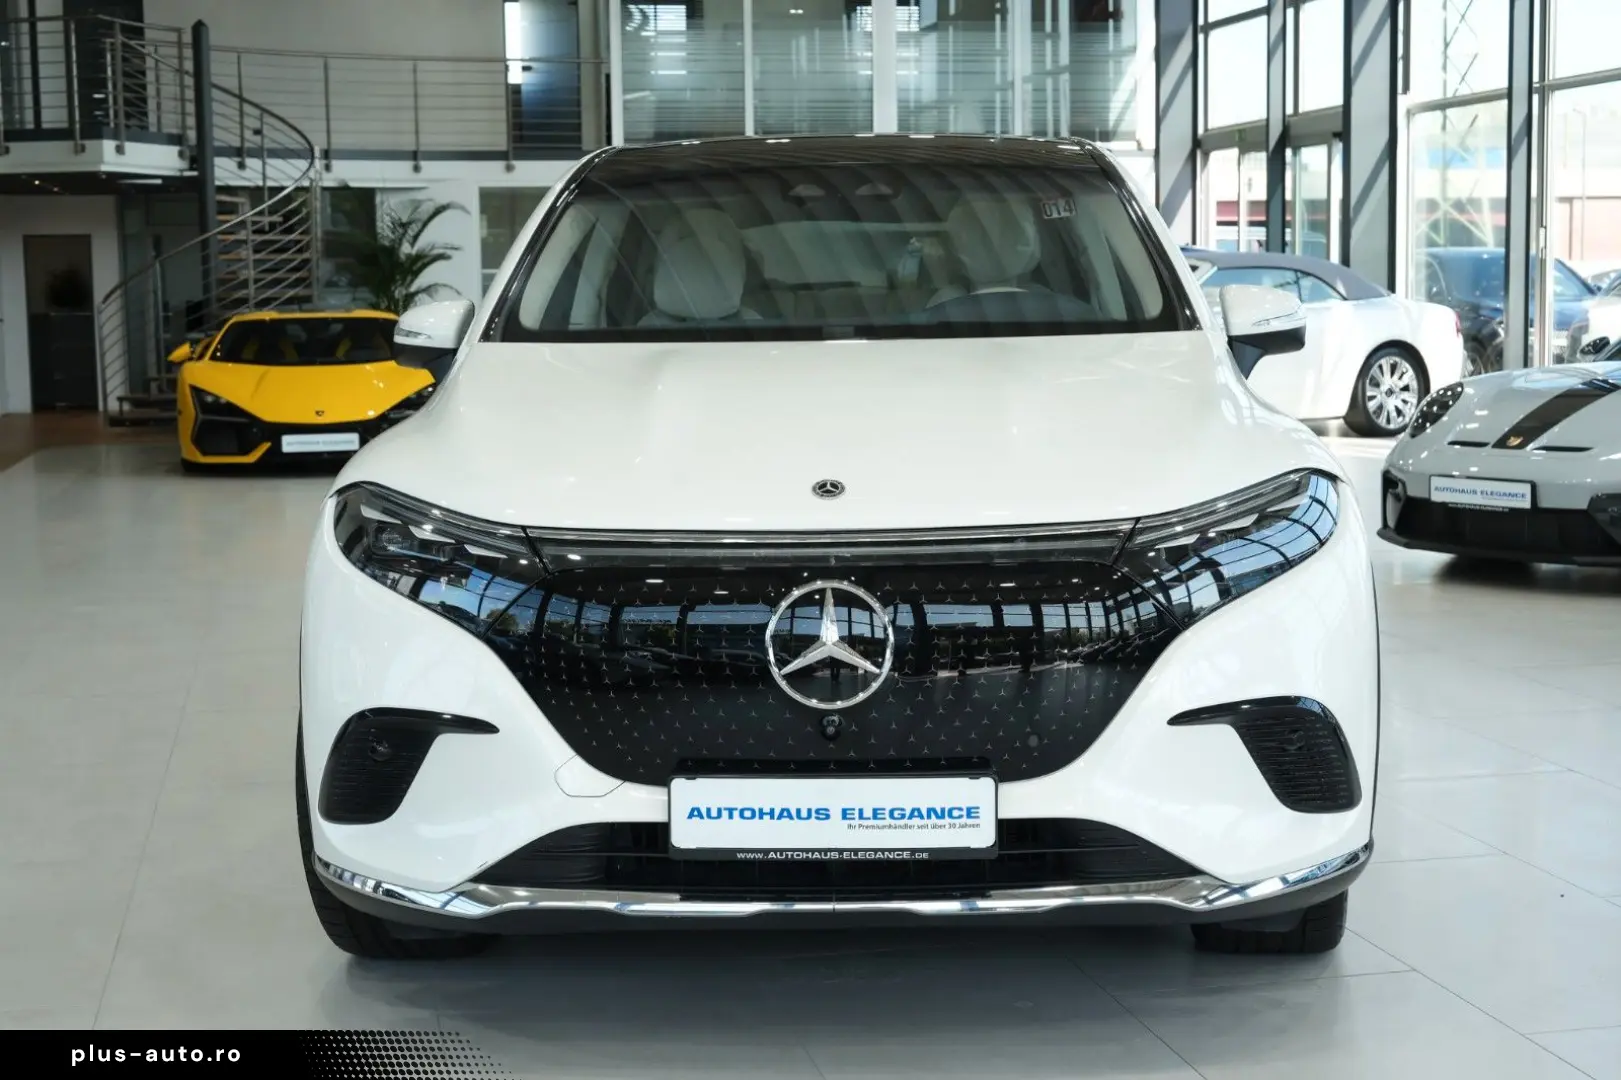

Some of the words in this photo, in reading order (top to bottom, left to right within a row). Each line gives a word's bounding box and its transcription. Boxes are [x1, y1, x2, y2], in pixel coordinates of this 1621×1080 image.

[1434, 486, 1478, 496] AUTOHAUS
[1480, 489, 1527, 499] ELEGANCE
[686, 806, 831, 820] AUTOHAUS
[841, 806, 981, 820] ELEGANCE
[930, 822, 946, 830] über
[947, 822, 957, 830] 30
